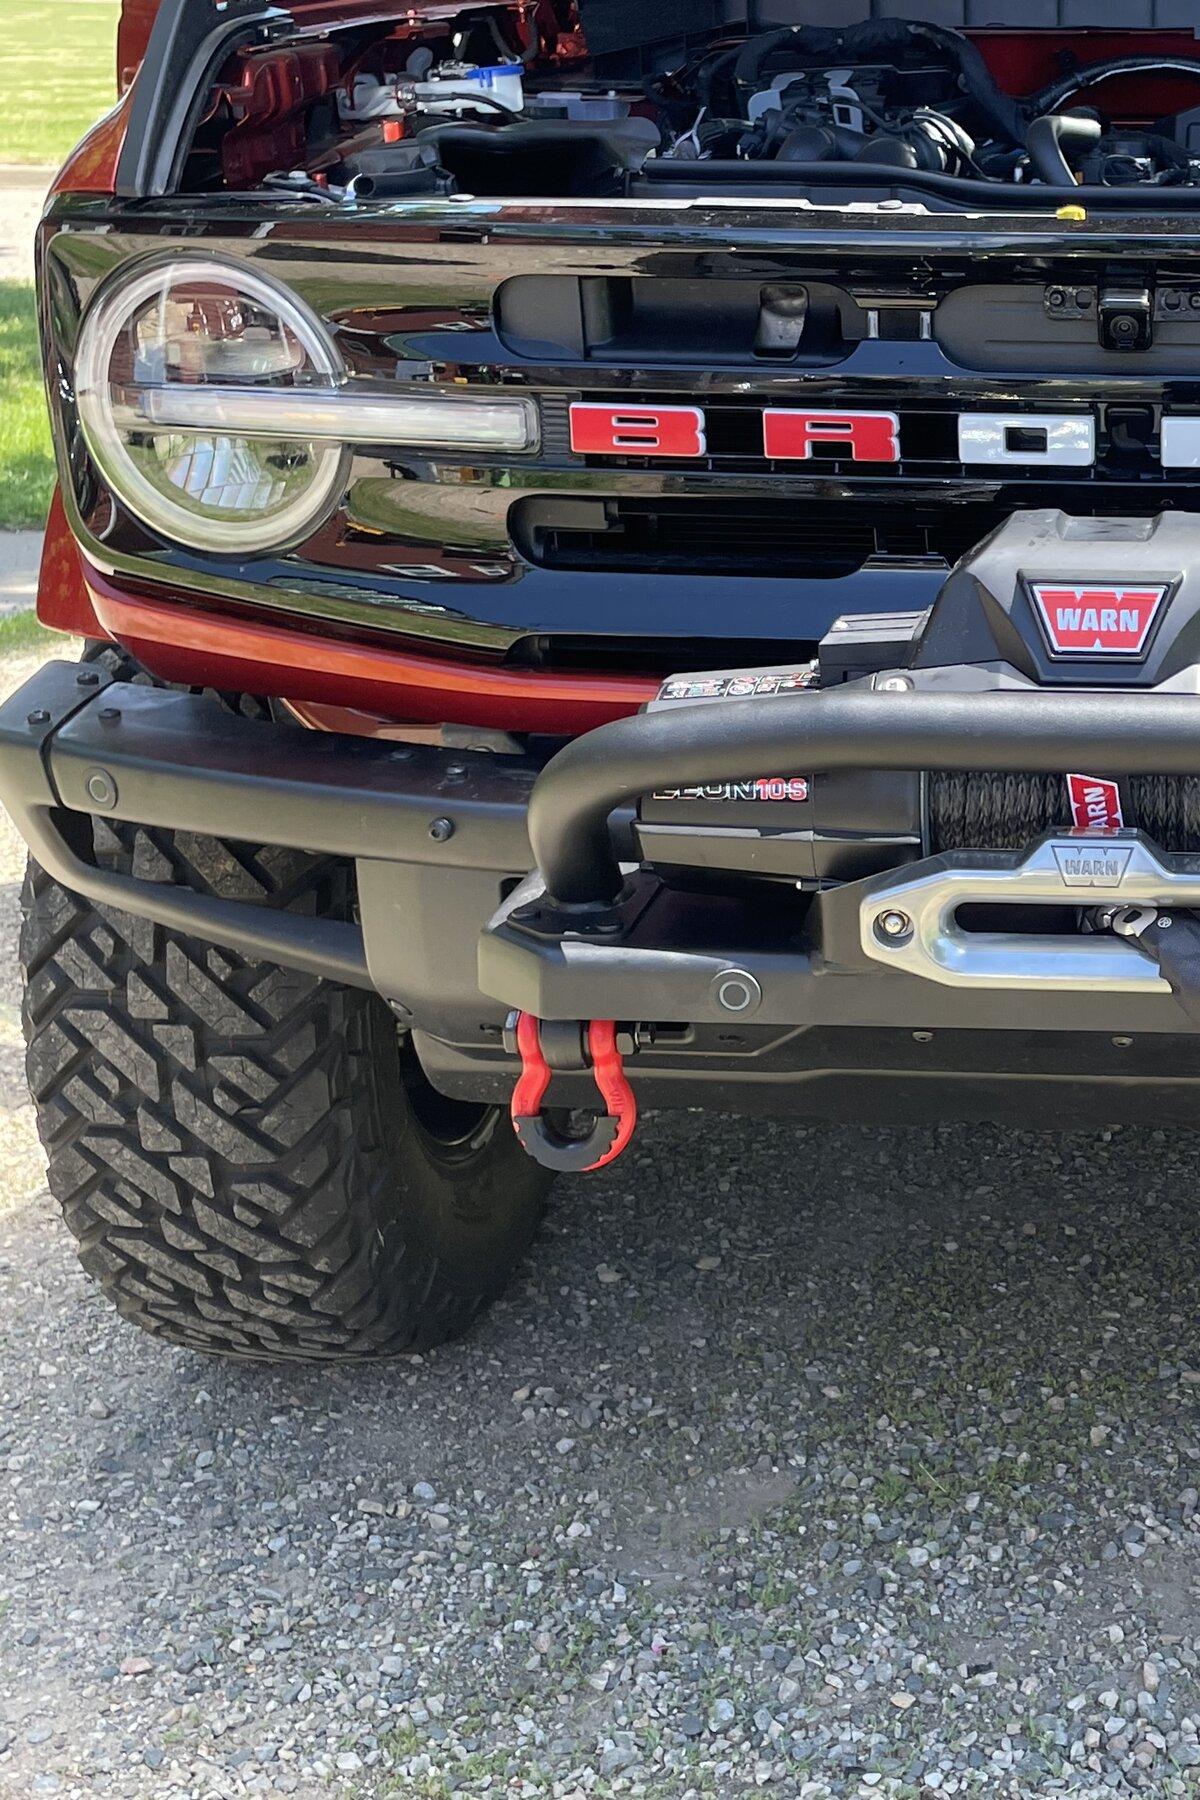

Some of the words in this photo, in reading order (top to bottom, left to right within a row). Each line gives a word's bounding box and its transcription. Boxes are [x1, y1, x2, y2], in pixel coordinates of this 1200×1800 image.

[1056, 608, 1140, 632] WARN
[1083, 786, 1109, 828] ARN
[1065, 859, 1119, 876] WARN
